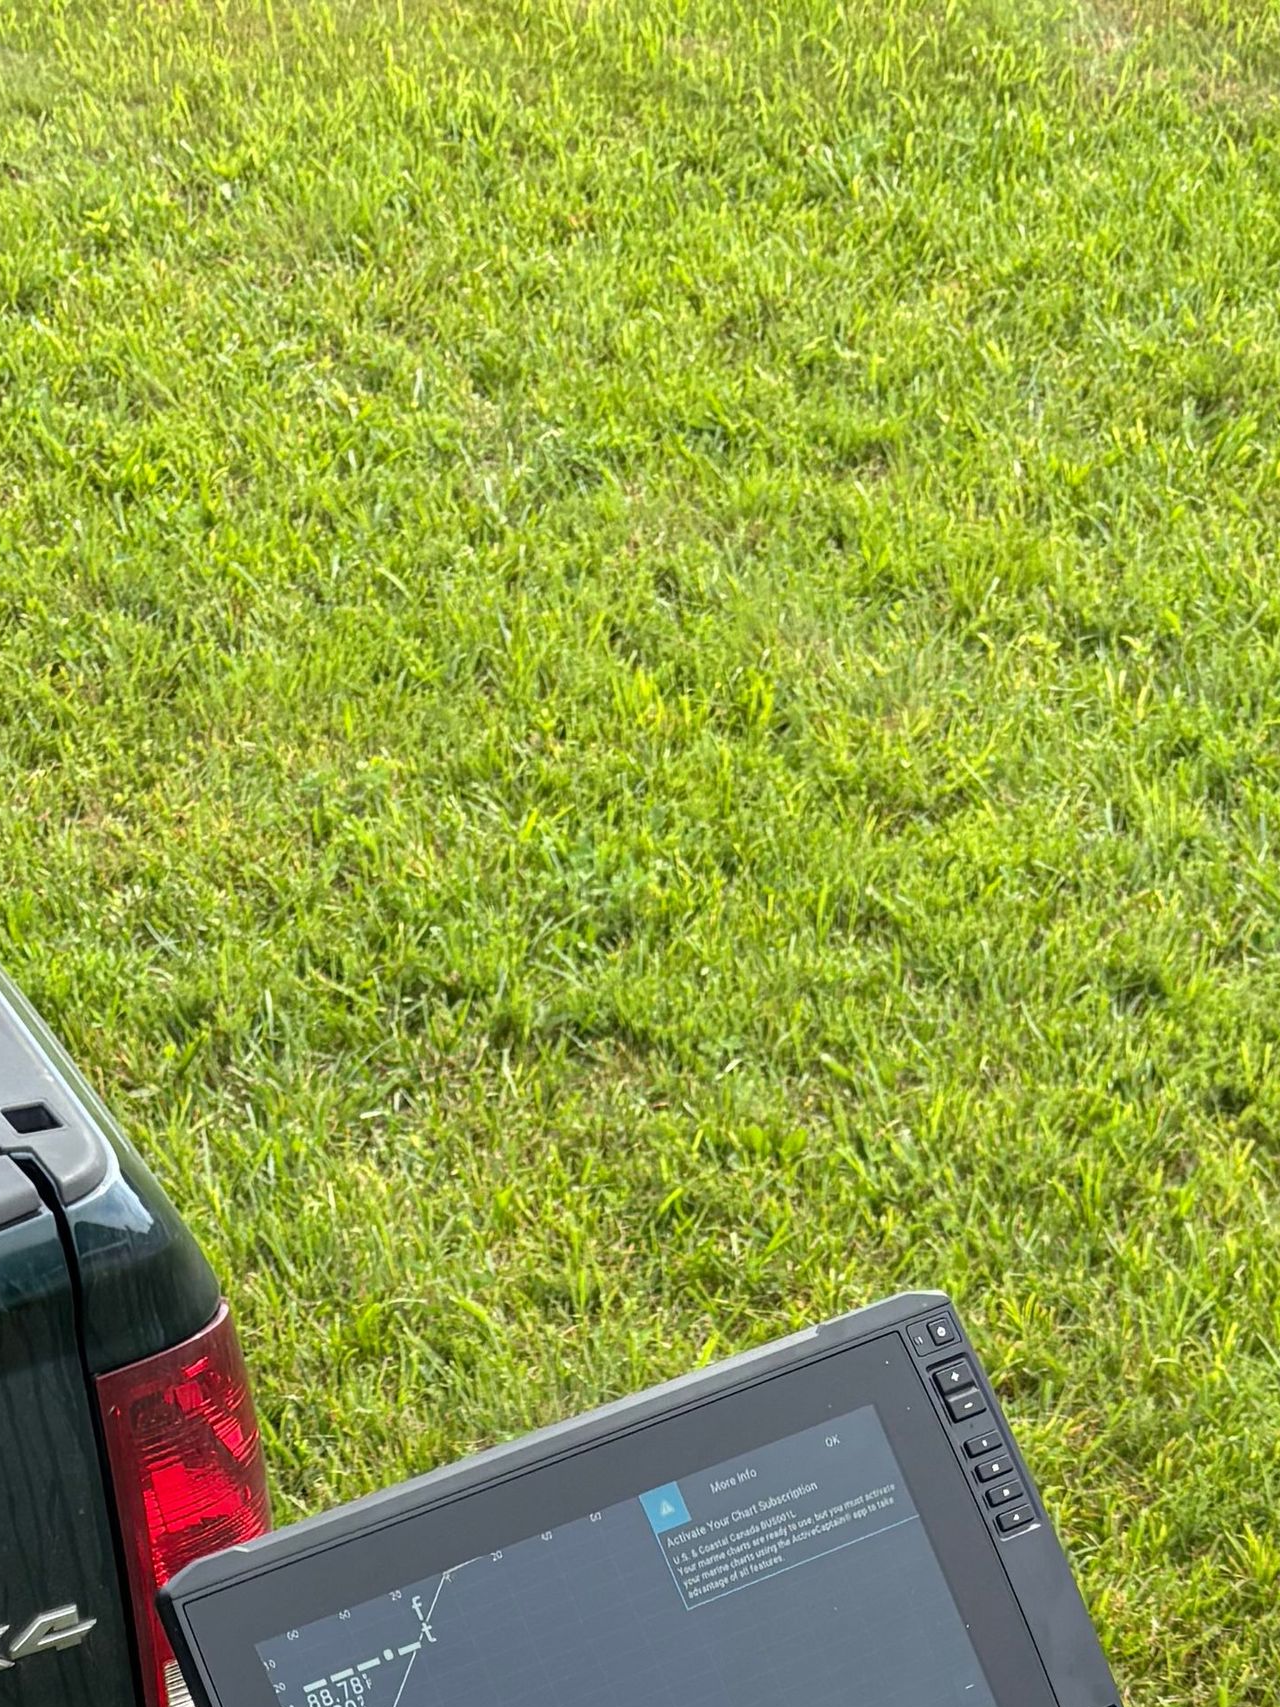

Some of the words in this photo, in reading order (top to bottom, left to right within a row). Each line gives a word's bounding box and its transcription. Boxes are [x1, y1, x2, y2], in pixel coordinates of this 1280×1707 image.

[824, 1433, 839, 1447] OK
[710, 1475, 736, 1492] More
[736, 1466, 757, 1482] Info
[665, 1524, 706, 1548] Activate
[706, 1515, 730, 1531] Your
[730, 1504, 757, 1522] Chart
[758, 1480, 817, 1511] Subscription
[698, 1536, 728, 1554] Coastal
[729, 1523, 760, 1541] Canada
[678, 1562, 696, 1575] Your
[697, 1552, 725, 1567] marine
[725, 1540, 751, 1556] charts
[701, 1564, 729, 1579] marine
[729, 1552, 755, 1567] charts
